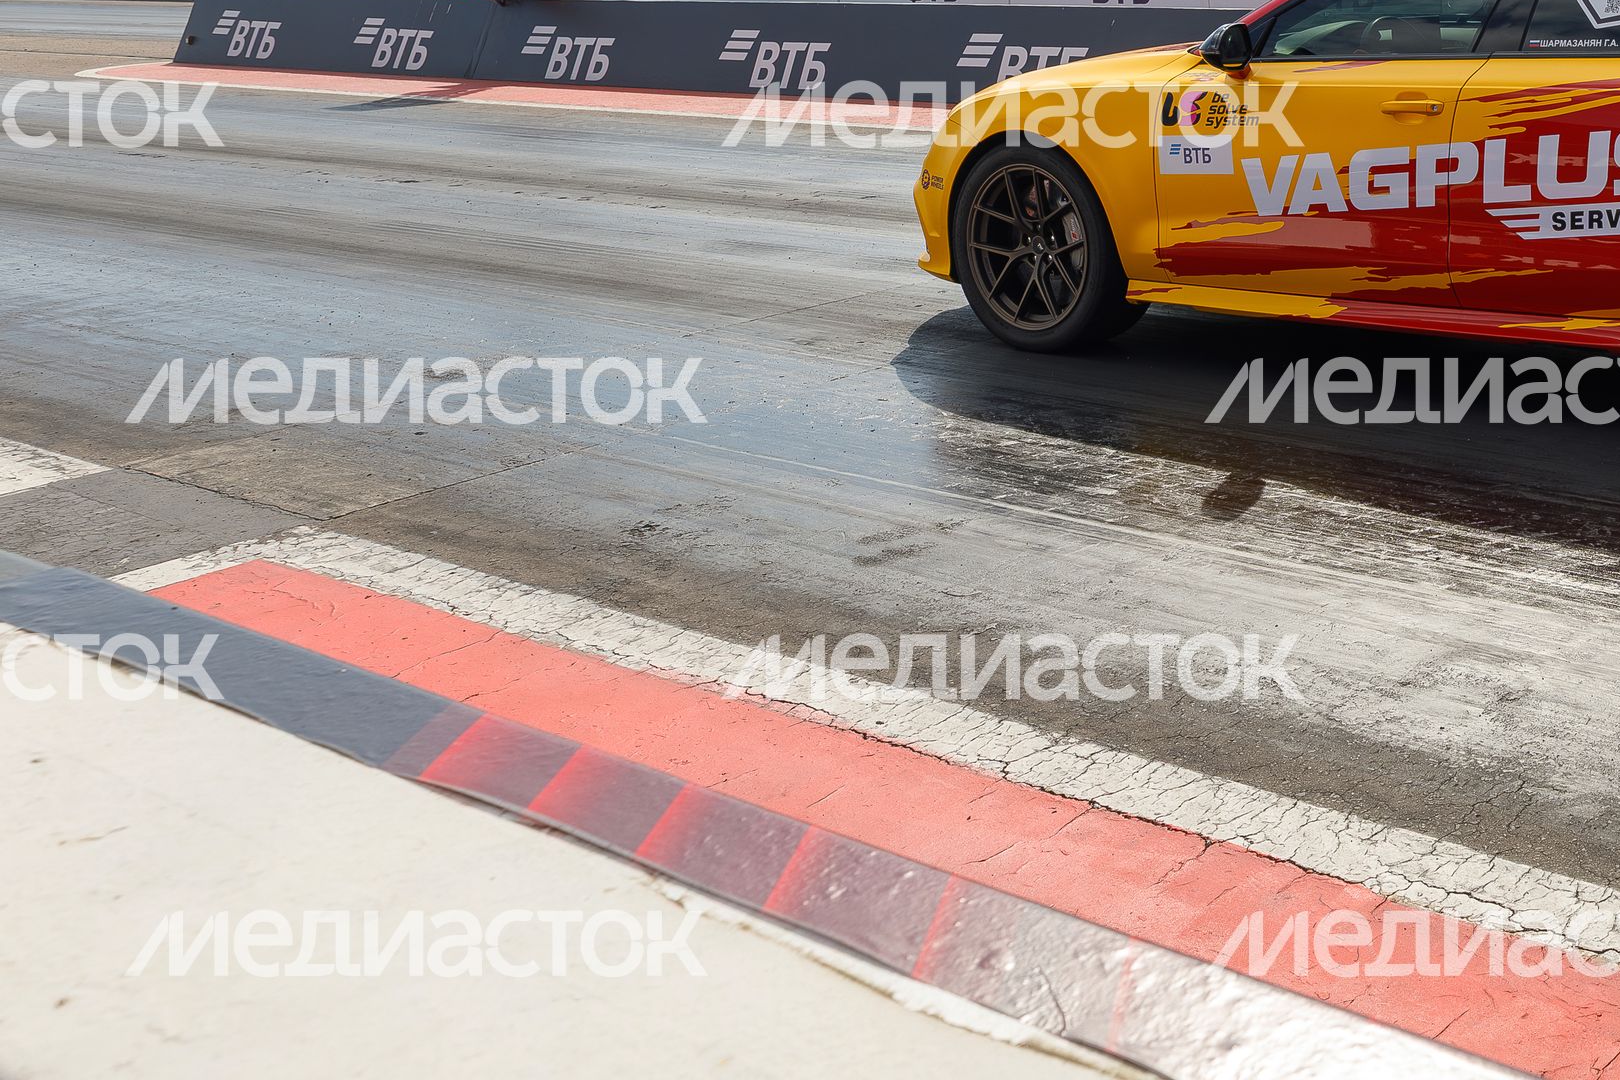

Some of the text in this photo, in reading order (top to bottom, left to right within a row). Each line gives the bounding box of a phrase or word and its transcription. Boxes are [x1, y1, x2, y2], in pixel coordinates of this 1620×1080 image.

[226, 20, 282, 59] ВТБ
[371, 27, 434, 71] ВТБ
[544, 36, 616, 81] ВТБ
[749, 41, 832, 90] ВТБ
[1205, 115, 1260, 129] system
[1183, 147, 1212, 164] ВТБ
